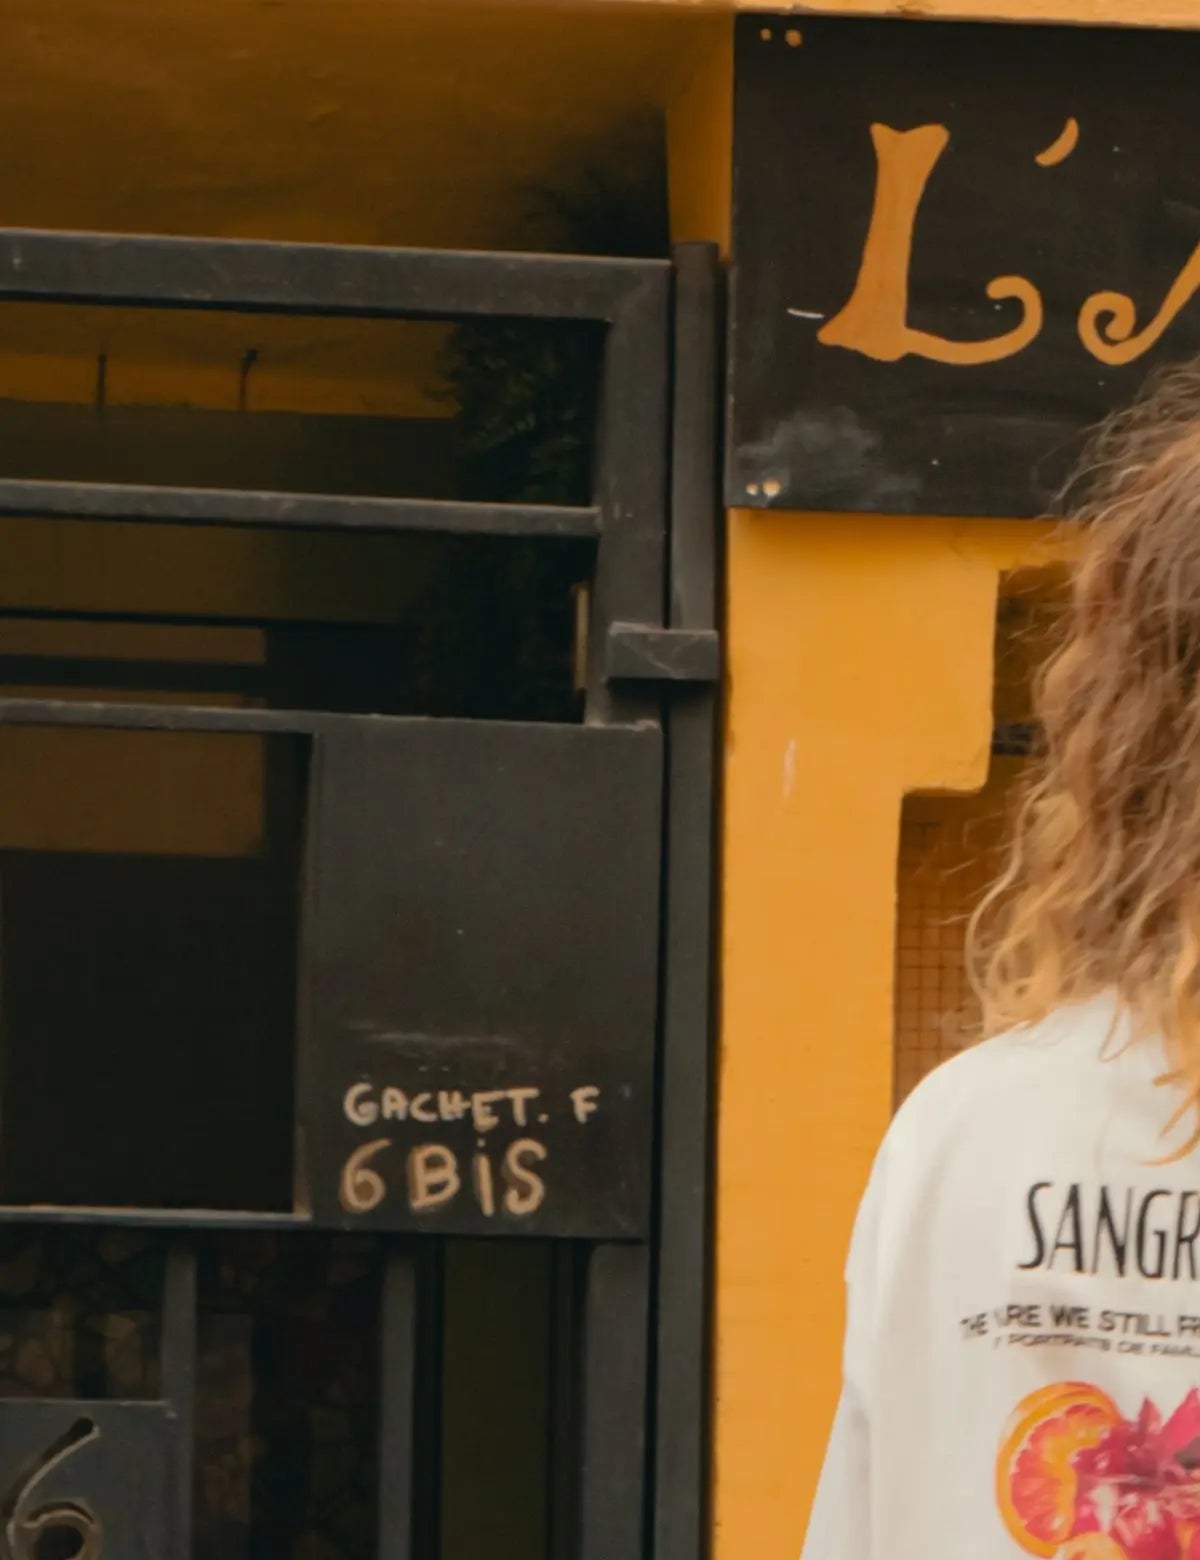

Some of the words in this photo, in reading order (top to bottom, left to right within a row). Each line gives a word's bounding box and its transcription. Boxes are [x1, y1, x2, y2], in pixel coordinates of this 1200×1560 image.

[570, 1085, 600, 1123] F
[340, 1138, 392, 1213] 6
[1049, 1306, 1090, 1329] WE
[1100, 1310, 1170, 1337] STILL
